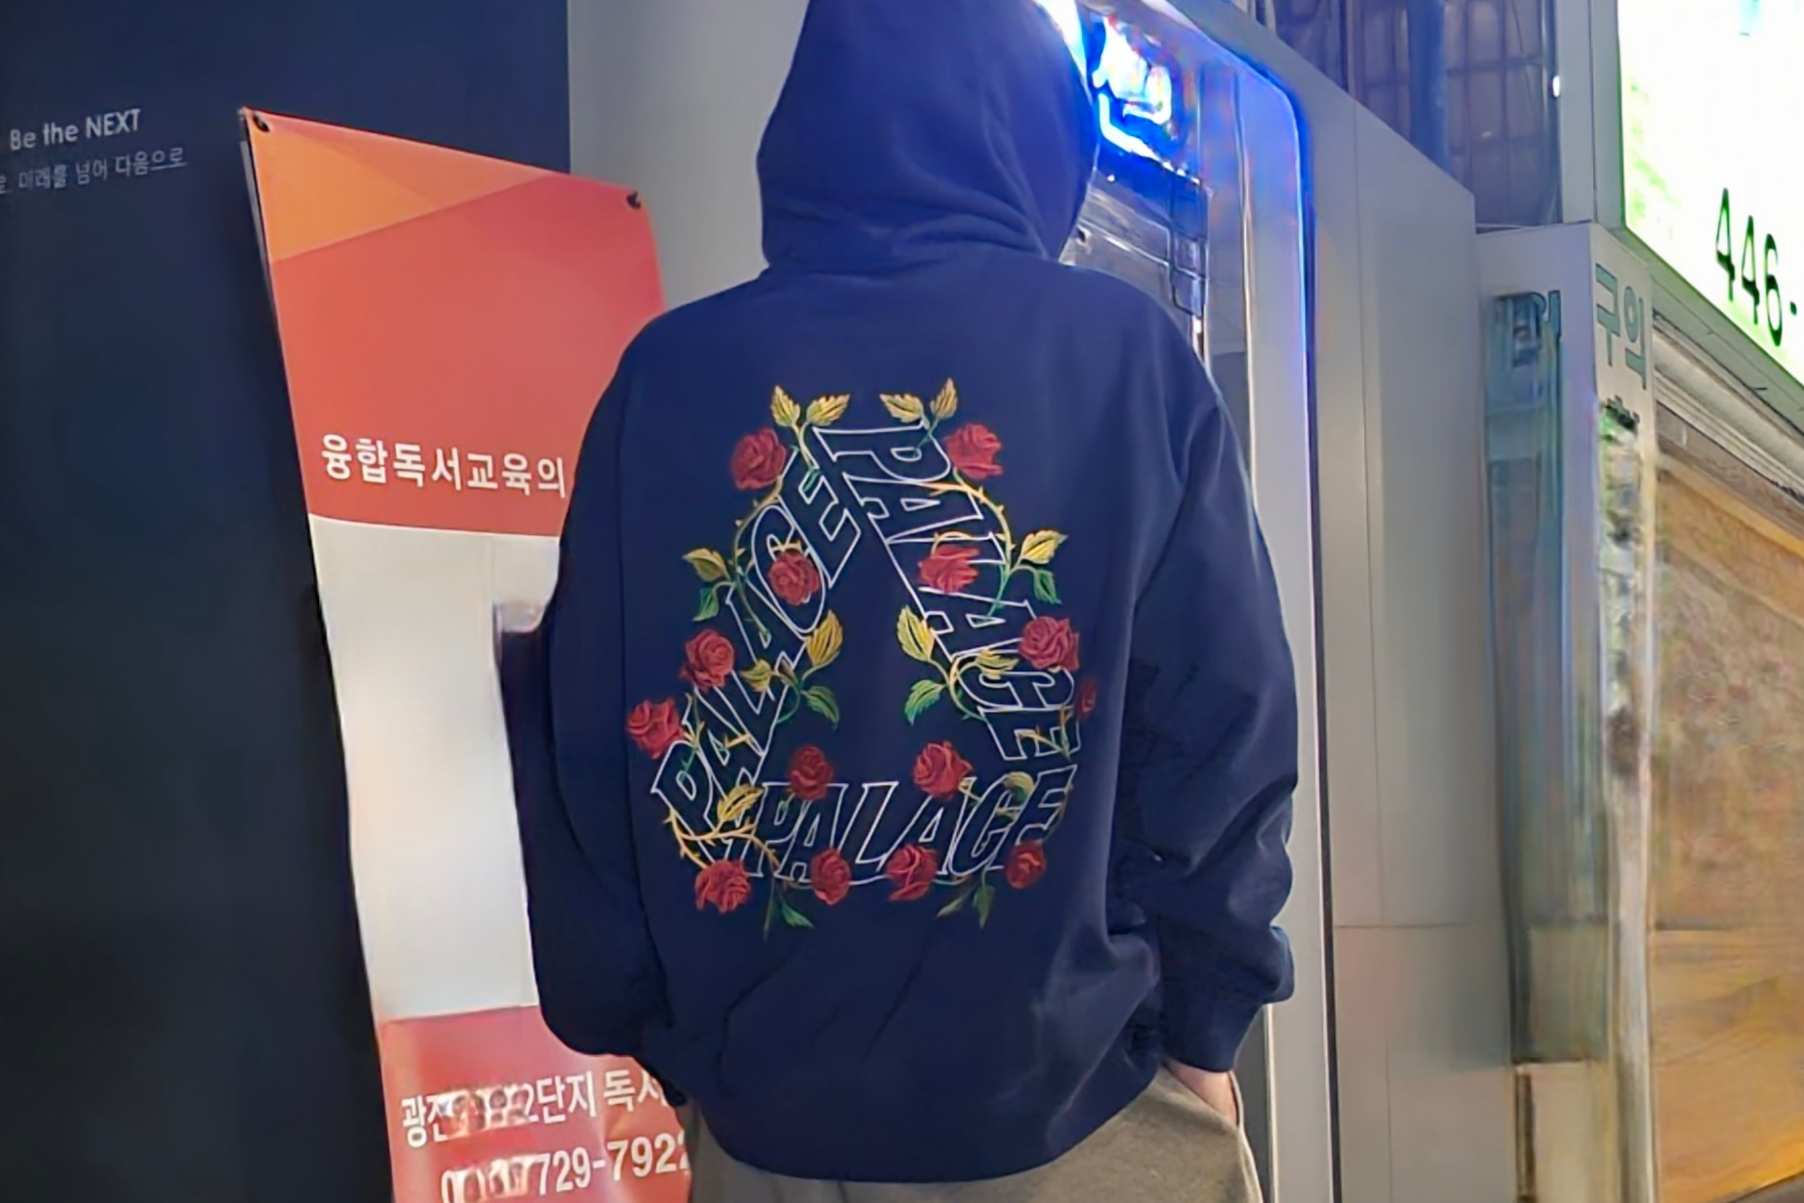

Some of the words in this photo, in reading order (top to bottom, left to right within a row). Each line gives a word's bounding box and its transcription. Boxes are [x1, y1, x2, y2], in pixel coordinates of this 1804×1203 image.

[10, 128, 36, 150] Be
[43, 122, 79, 146] the
[85, 108, 141, 138] NEXT
[75, 158, 108, 186] 넘어
[115, 147, 188, 176] 다음으로
[1596, 263, 1647, 391] 구의
[321, 433, 566, 499] 융합독서교육의
[735, 764, 1078, 884] PALACE
